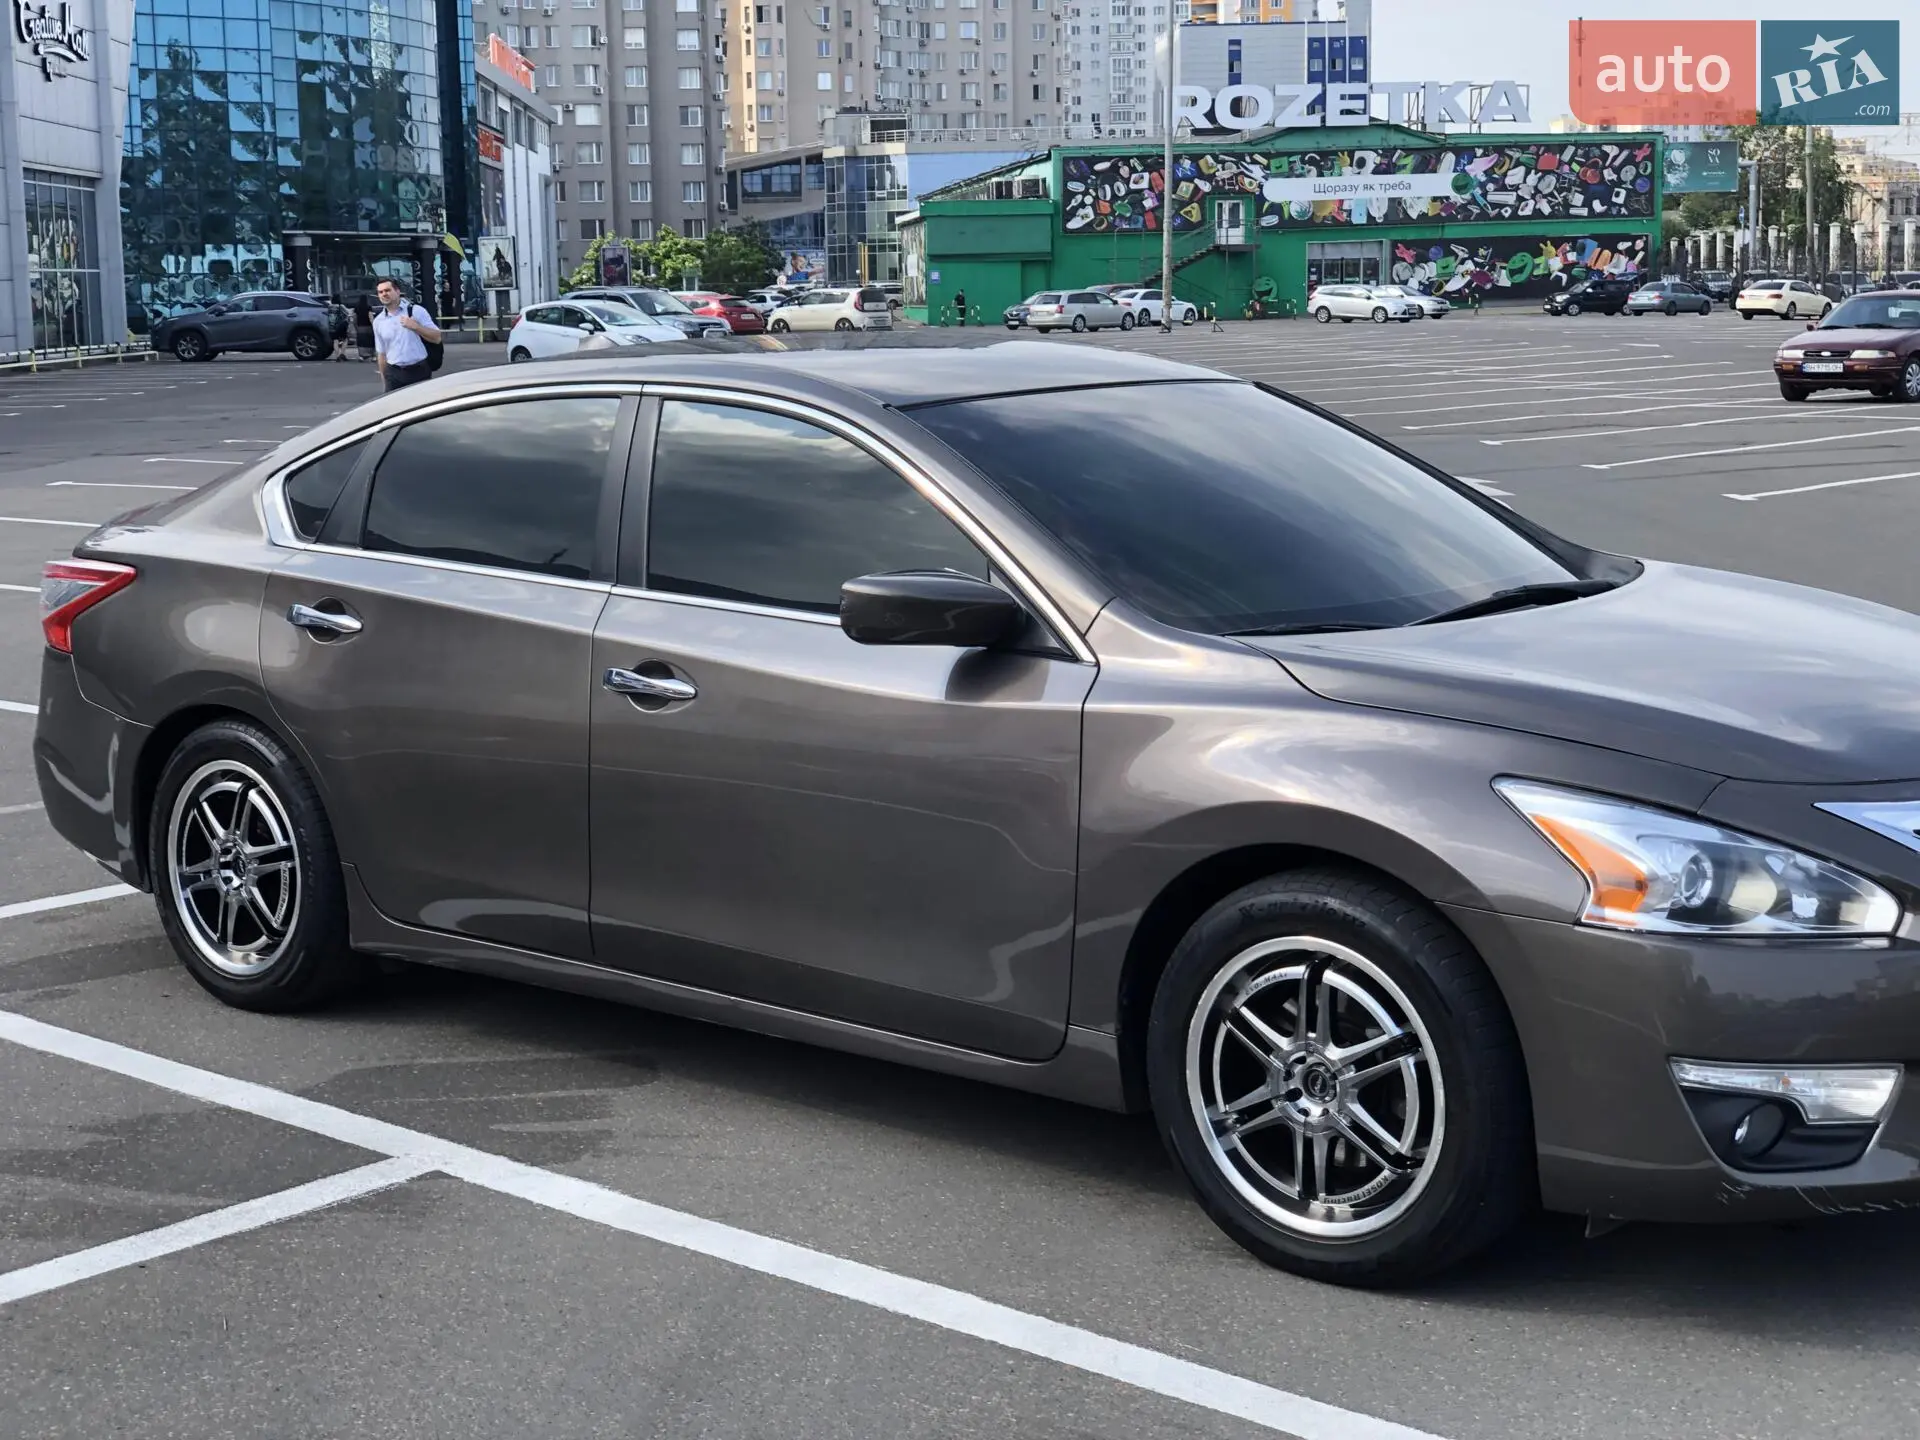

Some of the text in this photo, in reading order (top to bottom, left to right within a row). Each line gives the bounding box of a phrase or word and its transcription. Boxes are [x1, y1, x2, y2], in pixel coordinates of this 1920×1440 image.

[61, 2, 89, 61] Mall
[1172, 80, 1531, 130] ROZETKA
[1313, 181, 1412, 195] Щоразу як треба
[1361, 1175, 1389, 1199] KOSEI
